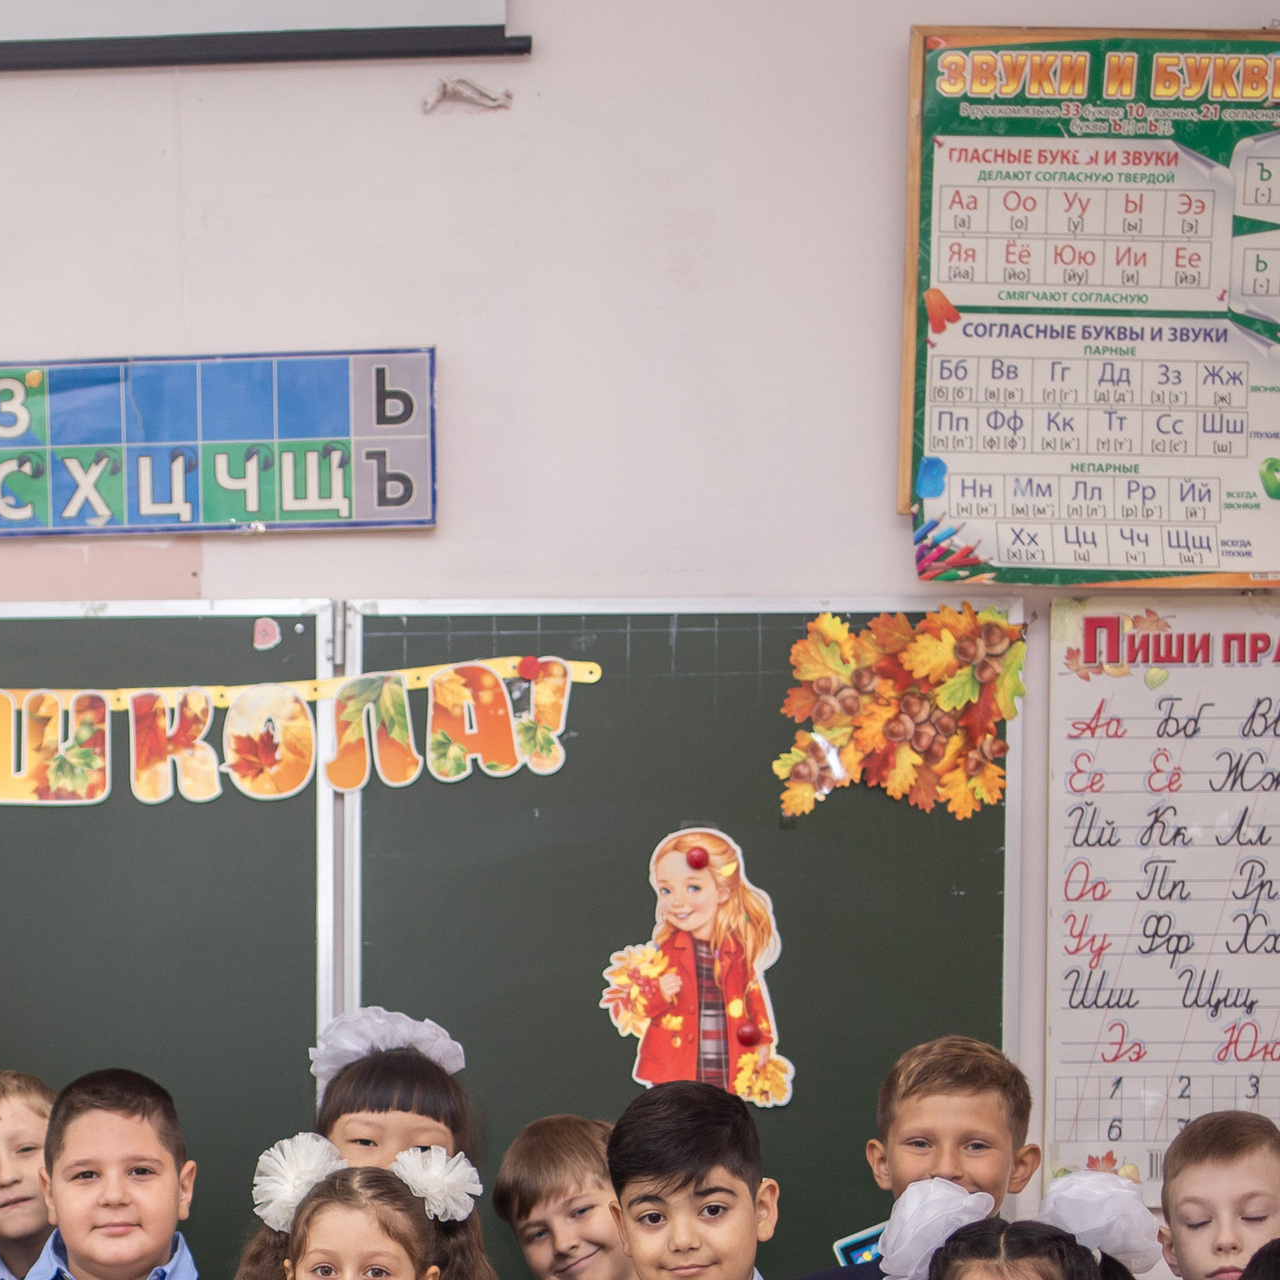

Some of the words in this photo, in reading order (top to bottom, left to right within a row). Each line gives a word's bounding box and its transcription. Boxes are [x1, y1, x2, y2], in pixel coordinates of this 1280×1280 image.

[937, 52, 1089, 97] ЗВУКИ
[1104, 52, 1137, 99] И
[1152, 53, 1280, 101] БУКВ
[1061, 102, 1081, 117] 33
[1126, 103, 1146, 118] 10
[1199, 104, 1219, 120] 21
[949, 149, 1032, 165] ГЛАСНЫЕ
[1104, 151, 1116, 166] И
[1122, 151, 1179, 167] ЗВУКИ
[978, 171, 1032, 182] ДЕЛАЮТ
[1035, 171, 1114, 184] СОГЛАСНУЮ
[1118, 171, 1175, 184] ТВЕРДОЙ
[1257, 162, 1272, 182] Ъ
[948, 190, 978, 210] Аа
[1003, 191, 1037, 212] Оо
[1063, 192, 1091, 218] Уу
[1124, 193, 1143, 214] Ы
[1177, 193, 1206, 215] Ээ
[948, 243, 976, 263] Яя
[1005, 239, 1031, 265] Ёё
[1053, 246, 1096, 267] Юю
[1115, 247, 1148, 268] Ии
[1175, 247, 1201, 269] Ее
[1256, 253, 1268, 273] Ь
[998, 290, 1068, 303] СМЯГЧАЮТ
[1071, 291, 1149, 304] СОГЛАСНУЮ
[962, 322, 1076, 340] СОГЛАСНЫЕ
[1081, 325, 1145, 342] БУКВЫ
[1150, 326, 1163, 342] И
[1167, 326, 1228, 344] ЗВУКИ
[1083, 346, 1137, 357] ПАРНЫЕ
[939, 360, 967, 380] Бб
[991, 360, 1019, 380] Вв
[1050, 362, 1070, 382] Гг
[1098, 363, 1131, 387] Дд
[1157, 364, 1182, 385] Зз
[1203, 365, 1244, 386] Жж
[373, 365, 415, 427] Ь
[938, 412, 969, 432] Пп
[986, 411, 1024, 436] Фф
[1047, 412, 1075, 433] Кк
[1103, 411, 1127, 432] Тт
[1156, 414, 1184, 435] Сс
[1202, 414, 1244, 434] Шш
[1071, 462, 1140, 474] НЕПАРНЫЕ
[60, 456, 112, 519] Х
[137, 454, 192, 522] Ц
[214, 453, 261, 513] Ч
[281, 450, 351, 518] Щ
[364, 449, 415, 508] Ъ
[961, 479, 992, 498] Нн
[1013, 478, 1052, 498] Мм
[1071, 481, 1102, 501] Лл
[1127, 481, 1156, 506] Рр
[1180, 479, 1212, 502] Йй
[1226, 491, 1258, 500] ВСЕГДА
[1010, 528, 1039, 547] Хх
[1064, 528, 1097, 551] Цц
[1120, 529, 1149, 547] Чч
[1167, 531, 1211, 552] Щщ
[1220, 539, 1252, 549] ВСЕГДА
[1068, 699, 1127, 738] Аа
[1156, 698, 1214, 738] Бб
[1069, 753, 1104, 793] Ее
[1148, 748, 1183, 793] Ёё
[1068, 802, 1121, 847] Йй
[1140, 806, 1193, 846] Кк
[1216, 806, 1271, 846] Лл
[1064, 861, 1112, 901] Оо
[1137, 860, 1190, 900] Пп
[1232, 860, 1278, 914] Рр
[1064, 914, 1112, 970] Уу
[1137, 914, 1194, 969] Фф
[1064, 970, 1139, 1009] Шш
[1178, 970, 1258, 1017] Щщ
[1101, 1023, 1147, 1062] Ээ
[1109, 1077, 1122, 1098] 1
[1178, 1077, 1191, 1098] 2
[1246, 1076, 1259, 1098] 3
[1108, 1119, 1121, 1141] 6
